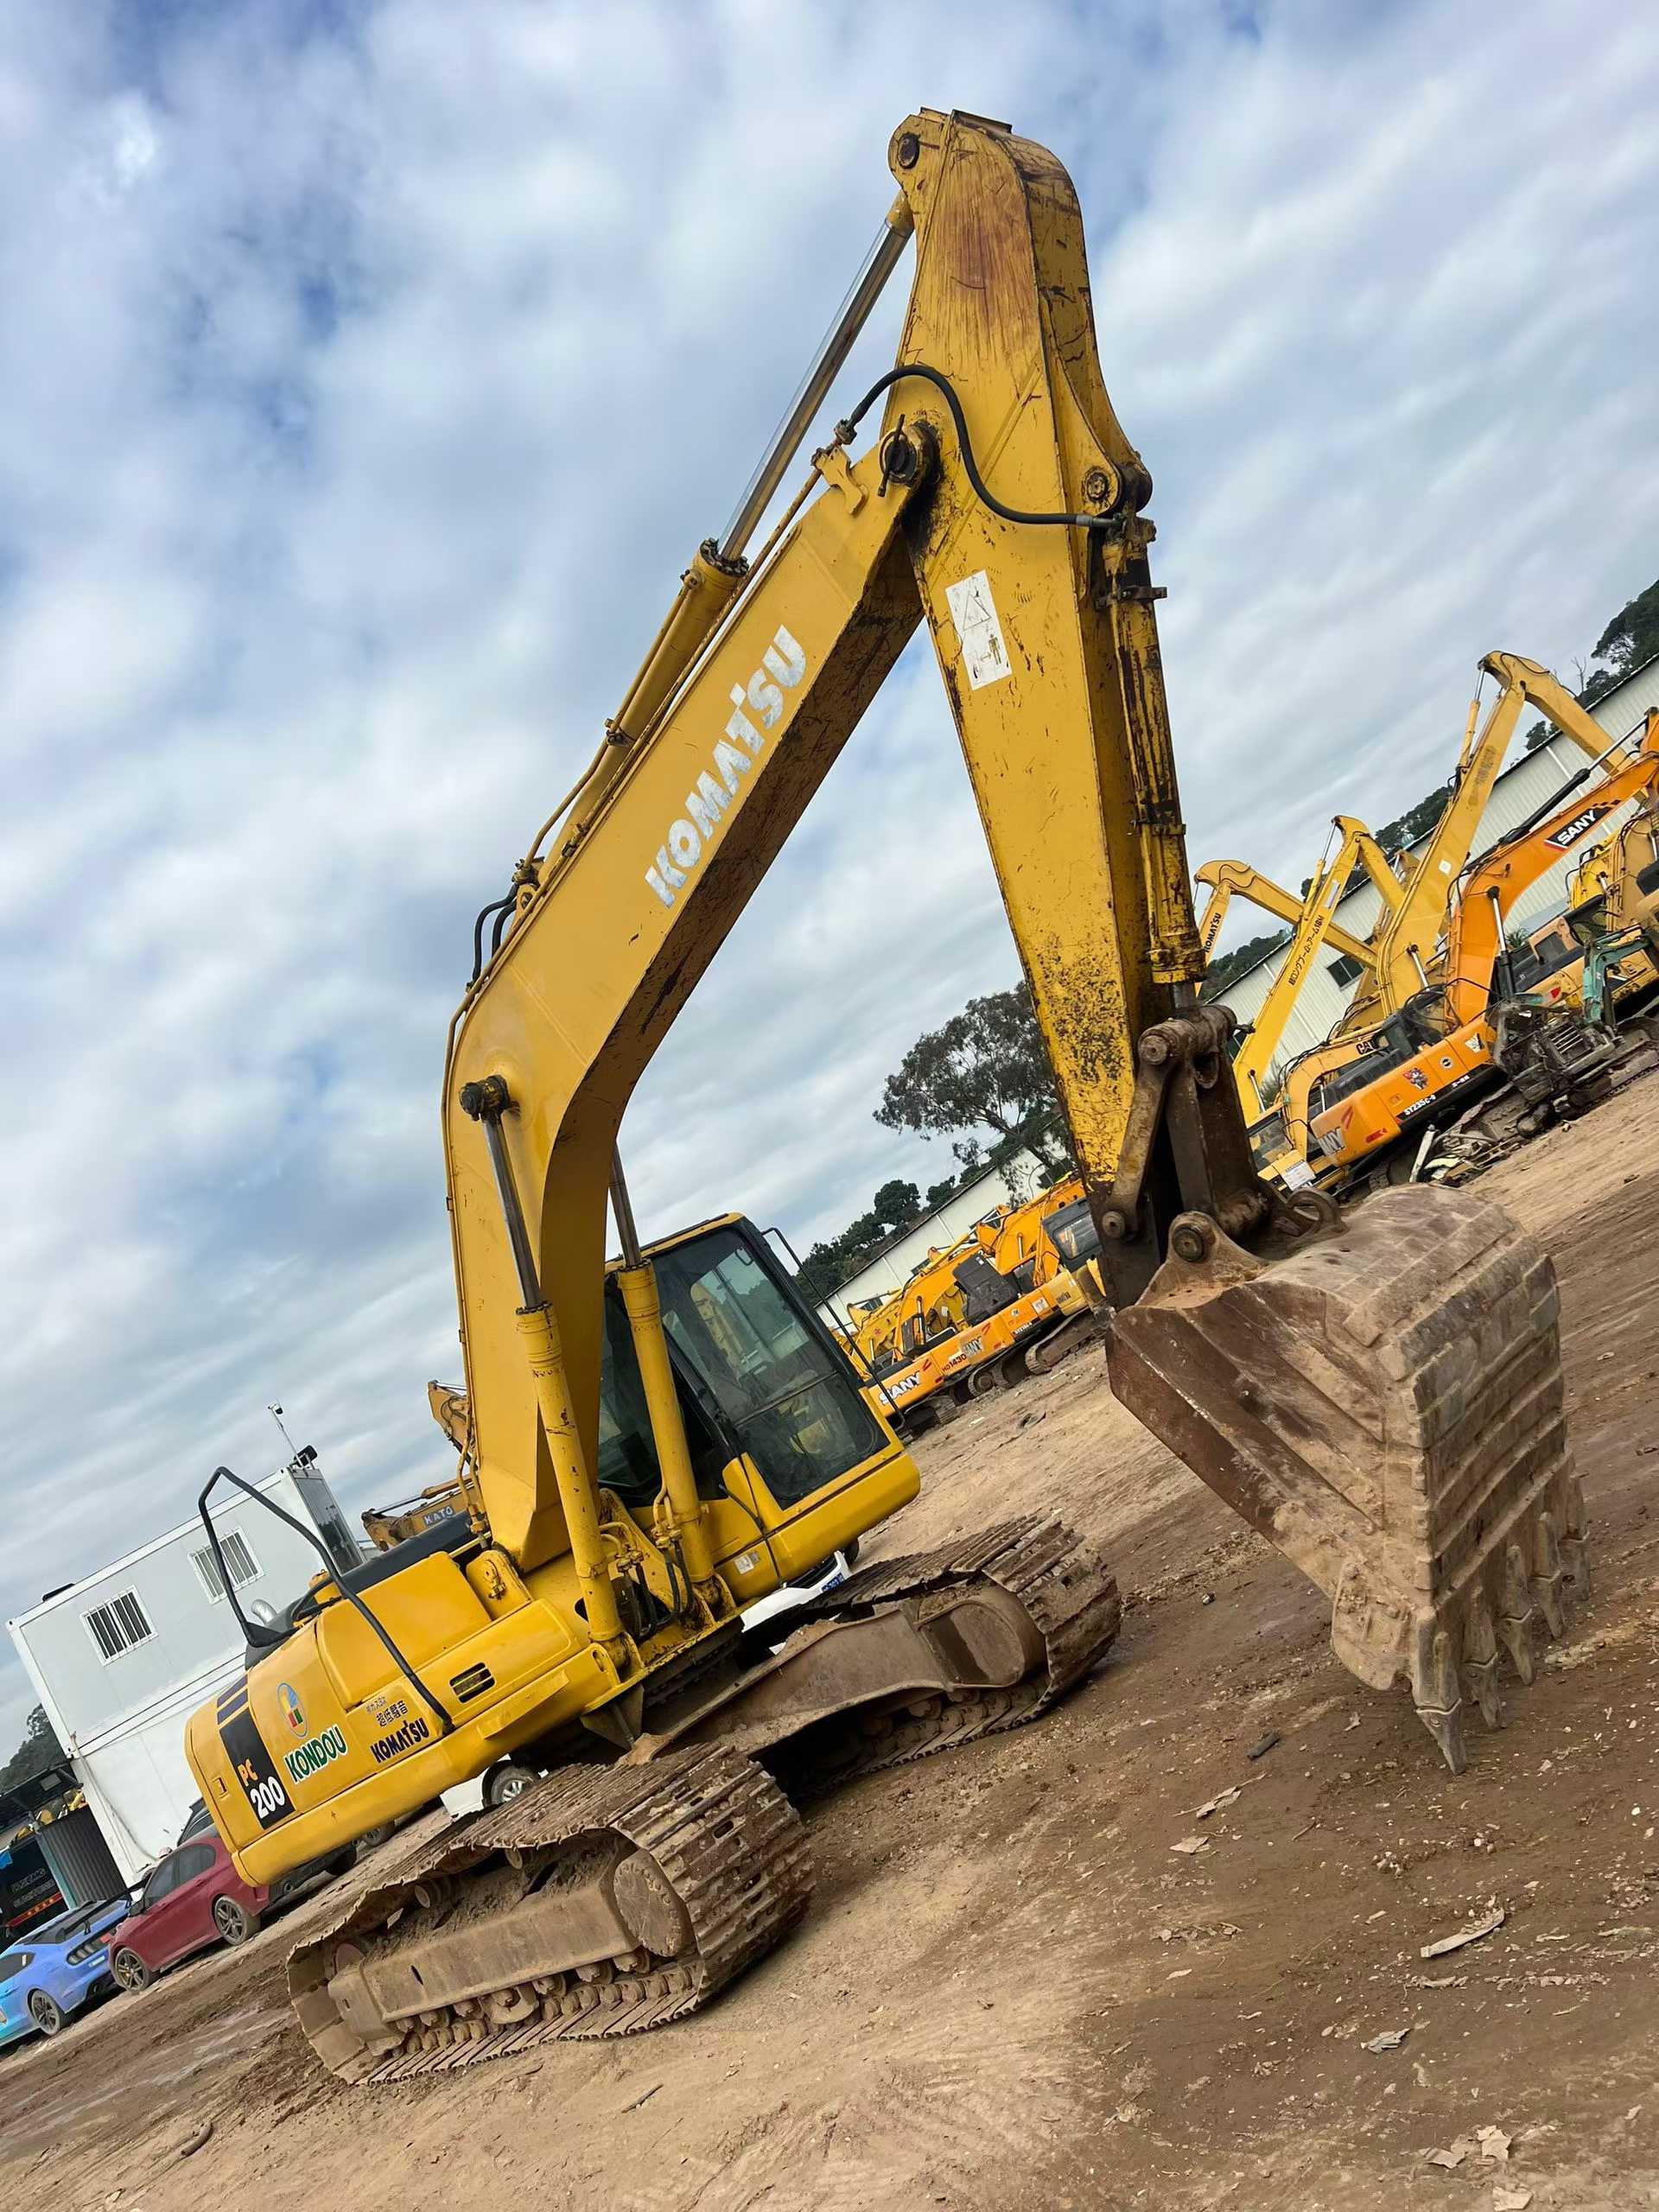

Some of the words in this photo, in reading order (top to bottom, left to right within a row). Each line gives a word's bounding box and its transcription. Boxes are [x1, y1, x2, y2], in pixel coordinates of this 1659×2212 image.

[645, 624, 806, 909] KOMATSU
[1557, 810, 1596, 844] SANY
[1203, 912, 1222, 953] KOMATSU
[424, 1506, 454, 1526] KATO
[283, 1724, 348, 1784] KONDOU
[370, 1717, 429, 1764] KOMATSU
[237, 1758, 258, 1787] PC
[250, 1776, 286, 1819] 200
